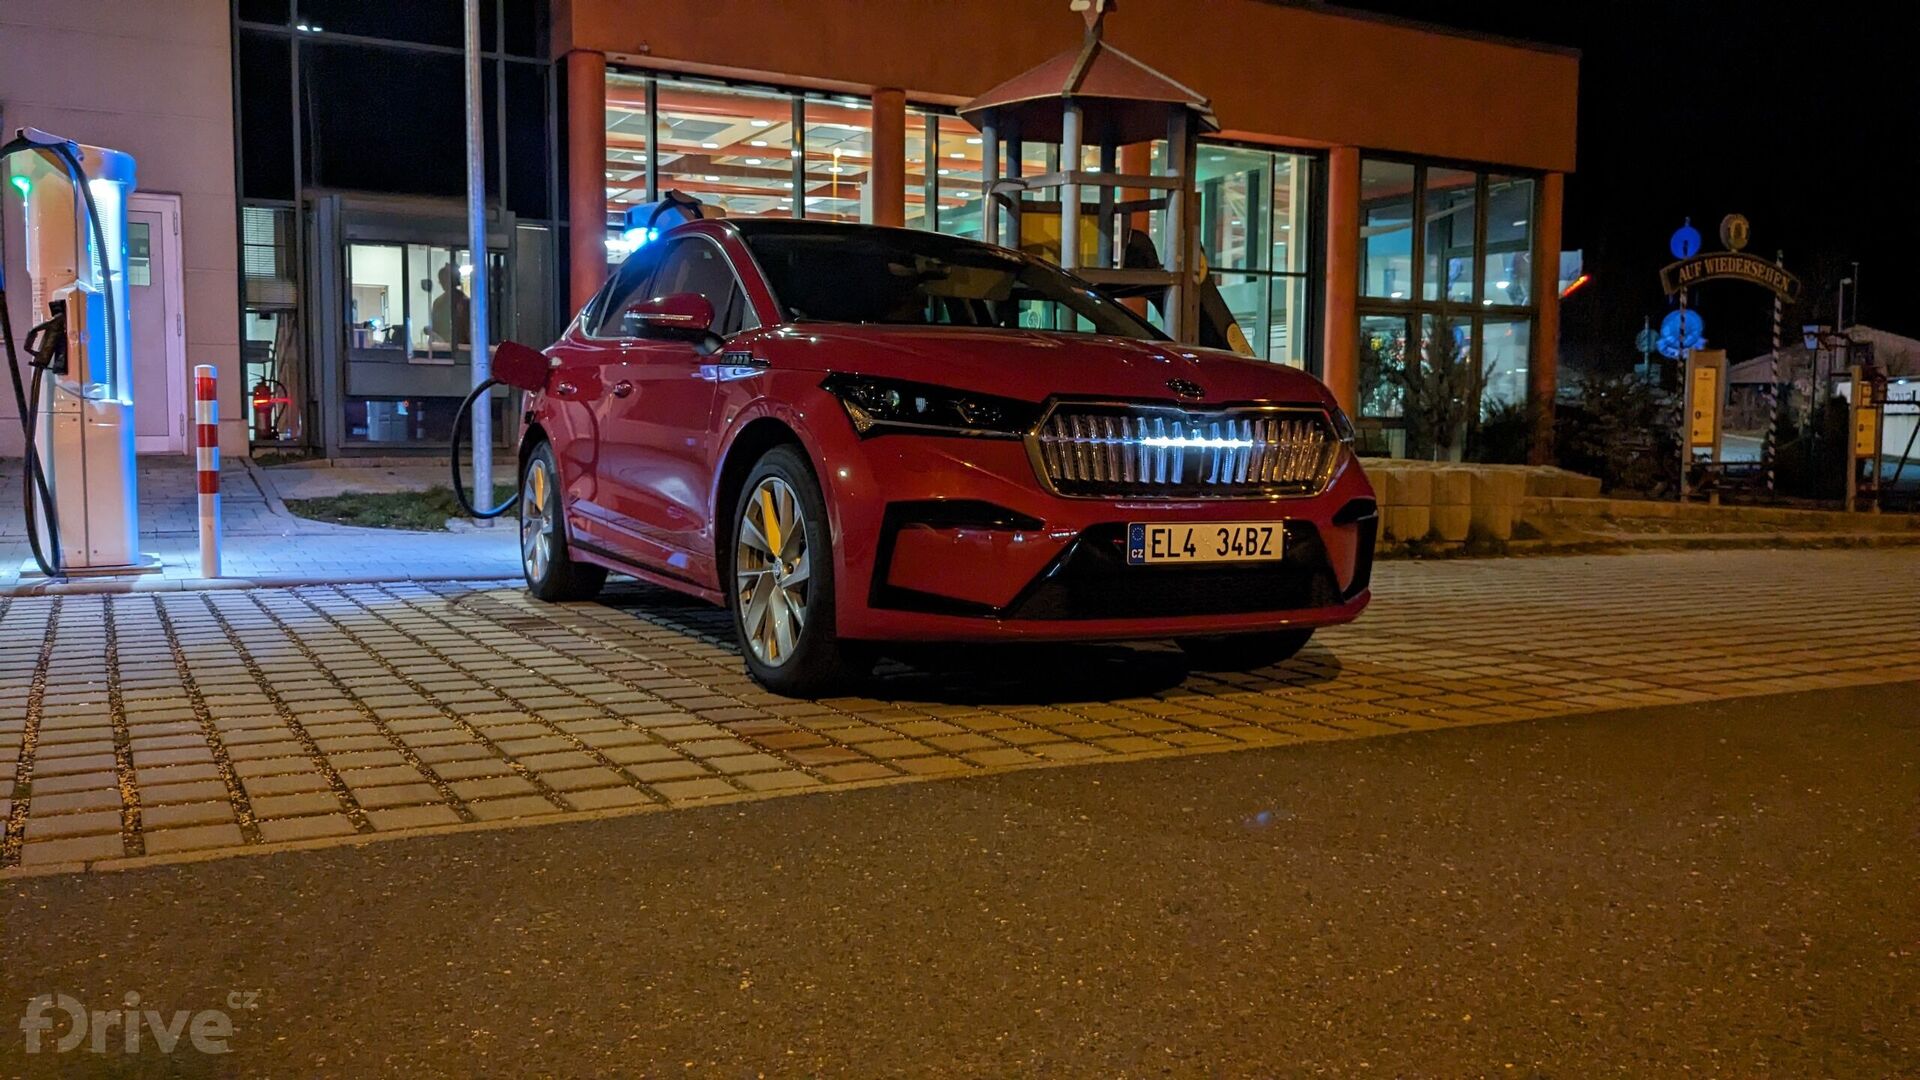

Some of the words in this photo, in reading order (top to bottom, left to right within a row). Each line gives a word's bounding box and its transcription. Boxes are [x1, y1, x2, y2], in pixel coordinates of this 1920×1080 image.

[1679, 262, 1702, 282] AUF
[1704, 257, 1790, 291] WIEDERSEHEN
[1131, 549, 1143, 558] CZ
[1151, 528, 1196, 558] EL4
[1217, 527, 1273, 556] 34BZ
